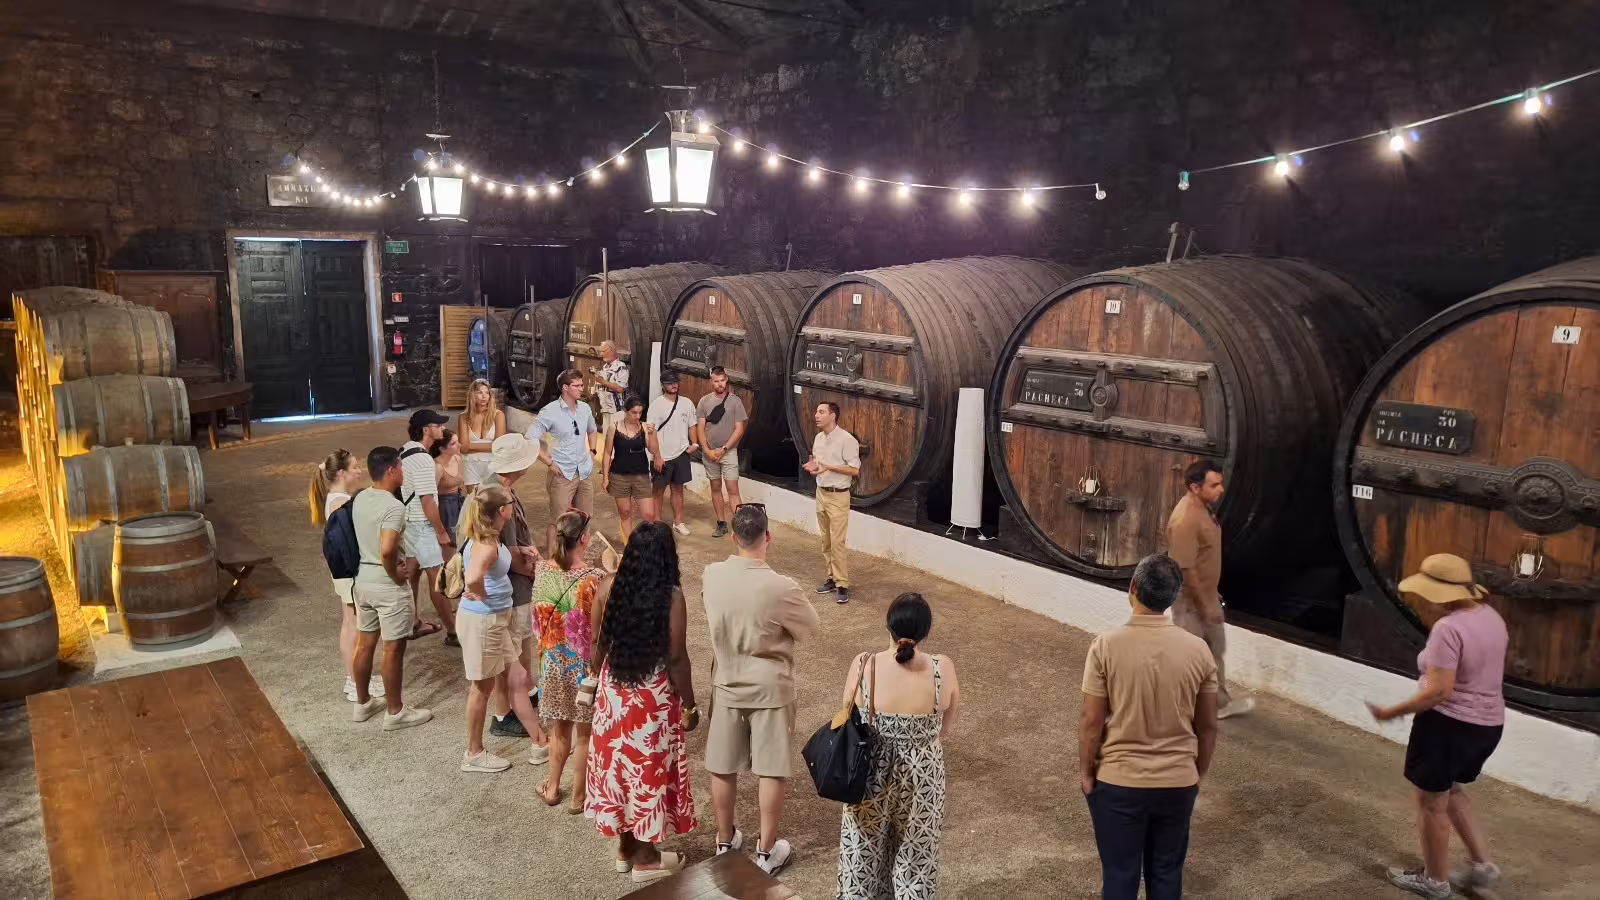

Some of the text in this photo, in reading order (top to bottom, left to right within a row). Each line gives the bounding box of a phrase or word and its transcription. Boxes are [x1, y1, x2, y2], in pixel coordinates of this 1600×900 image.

[1562, 328, 1571, 342] 9
[1025, 391, 1070, 407] PACHECA
[1074, 388, 1084, 397] 30
[1438, 416, 1457, 428] 30
[1376, 427, 1457, 450] PACHECA
